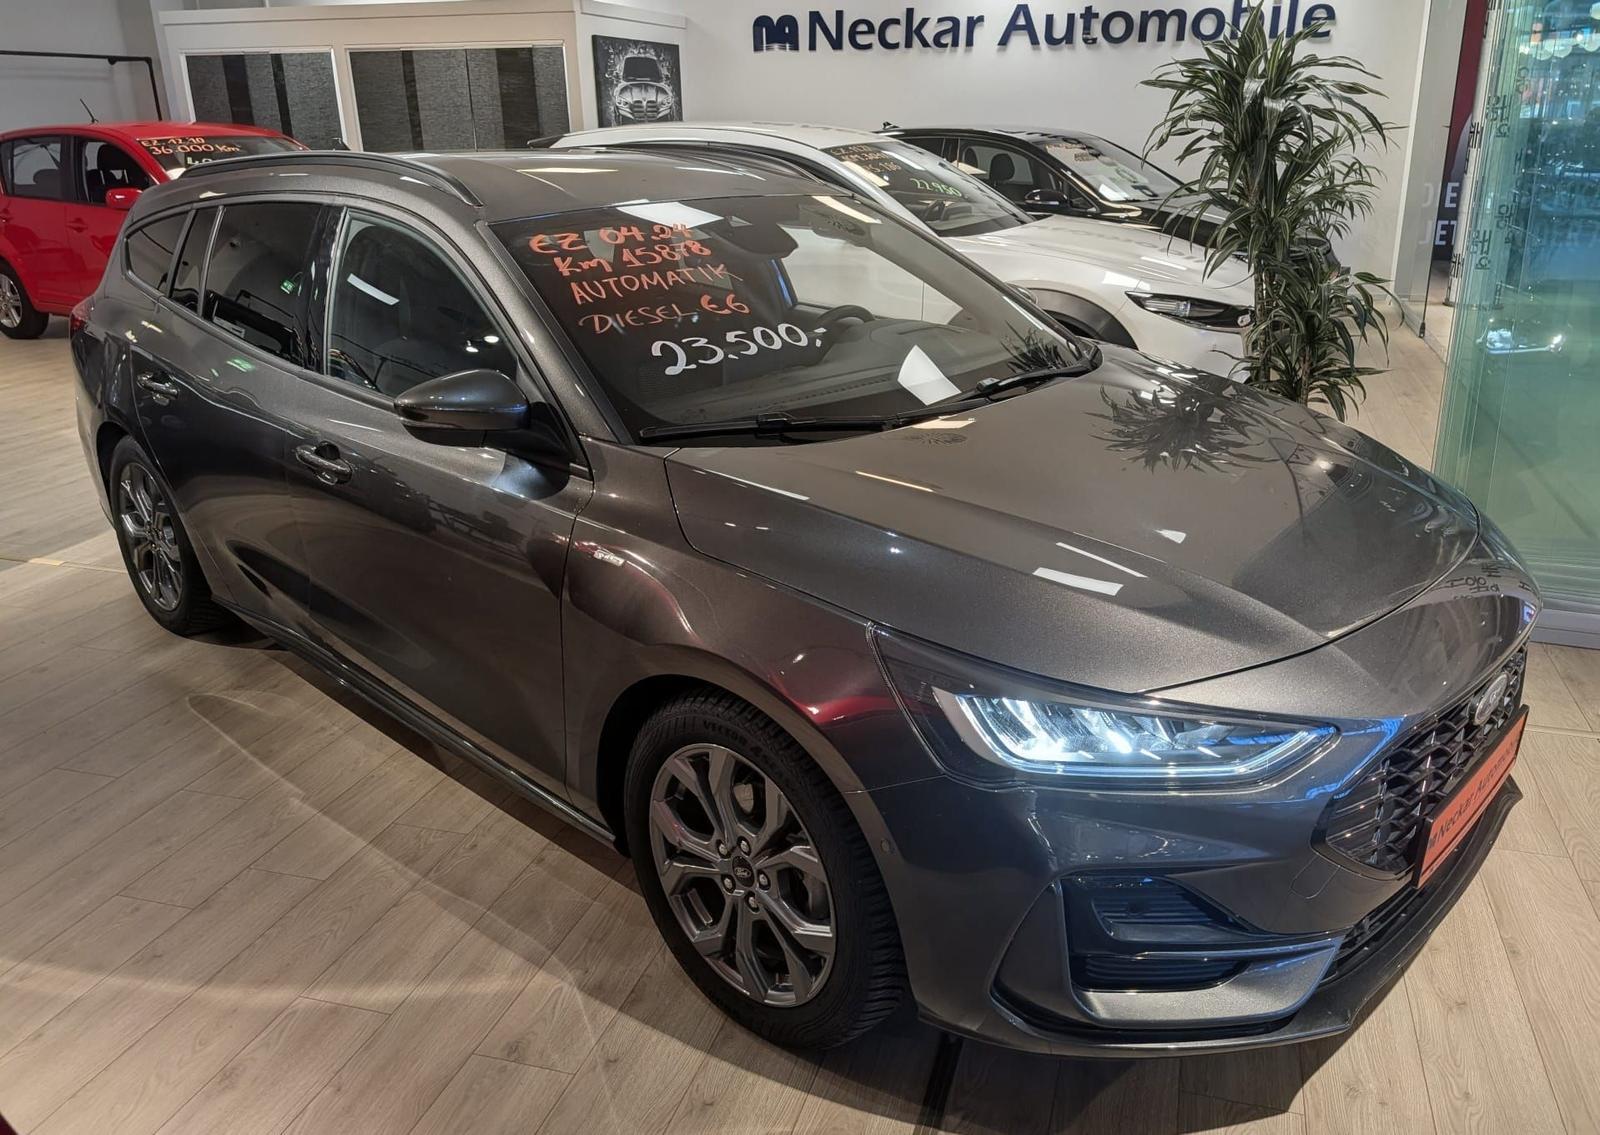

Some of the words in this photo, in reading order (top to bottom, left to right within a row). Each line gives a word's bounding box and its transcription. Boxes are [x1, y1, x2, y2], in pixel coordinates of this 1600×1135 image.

[808, 7, 984, 51] Neckar
[622, 239, 713, 268] 15878
[570, 262, 744, 305] AUTOMATIK
[578, 303, 697, 334] DIESEL
